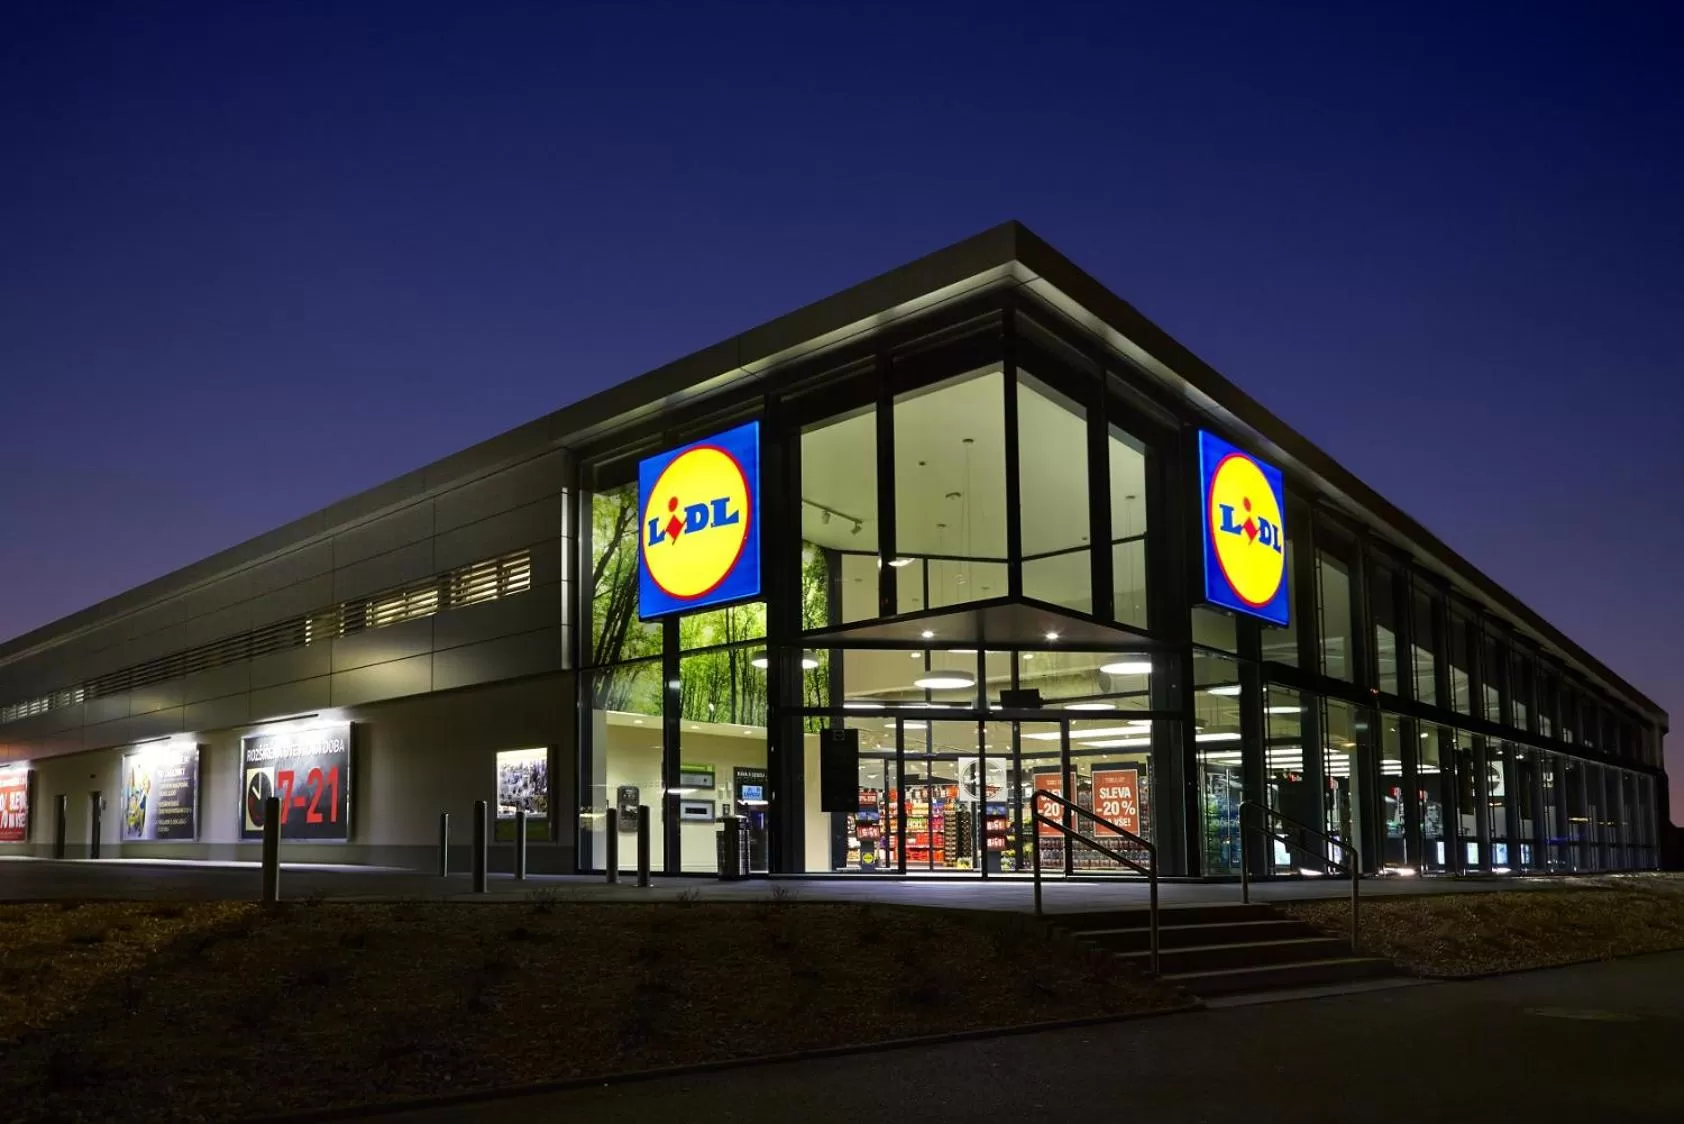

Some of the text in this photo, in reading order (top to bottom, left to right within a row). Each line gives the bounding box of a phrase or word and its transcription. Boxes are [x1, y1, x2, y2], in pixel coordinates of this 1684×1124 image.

[276, 765, 339, 824] 7-21
[1099, 786, 1132, 799] SLEVA
[1096, 801, 1120, 816] -20
